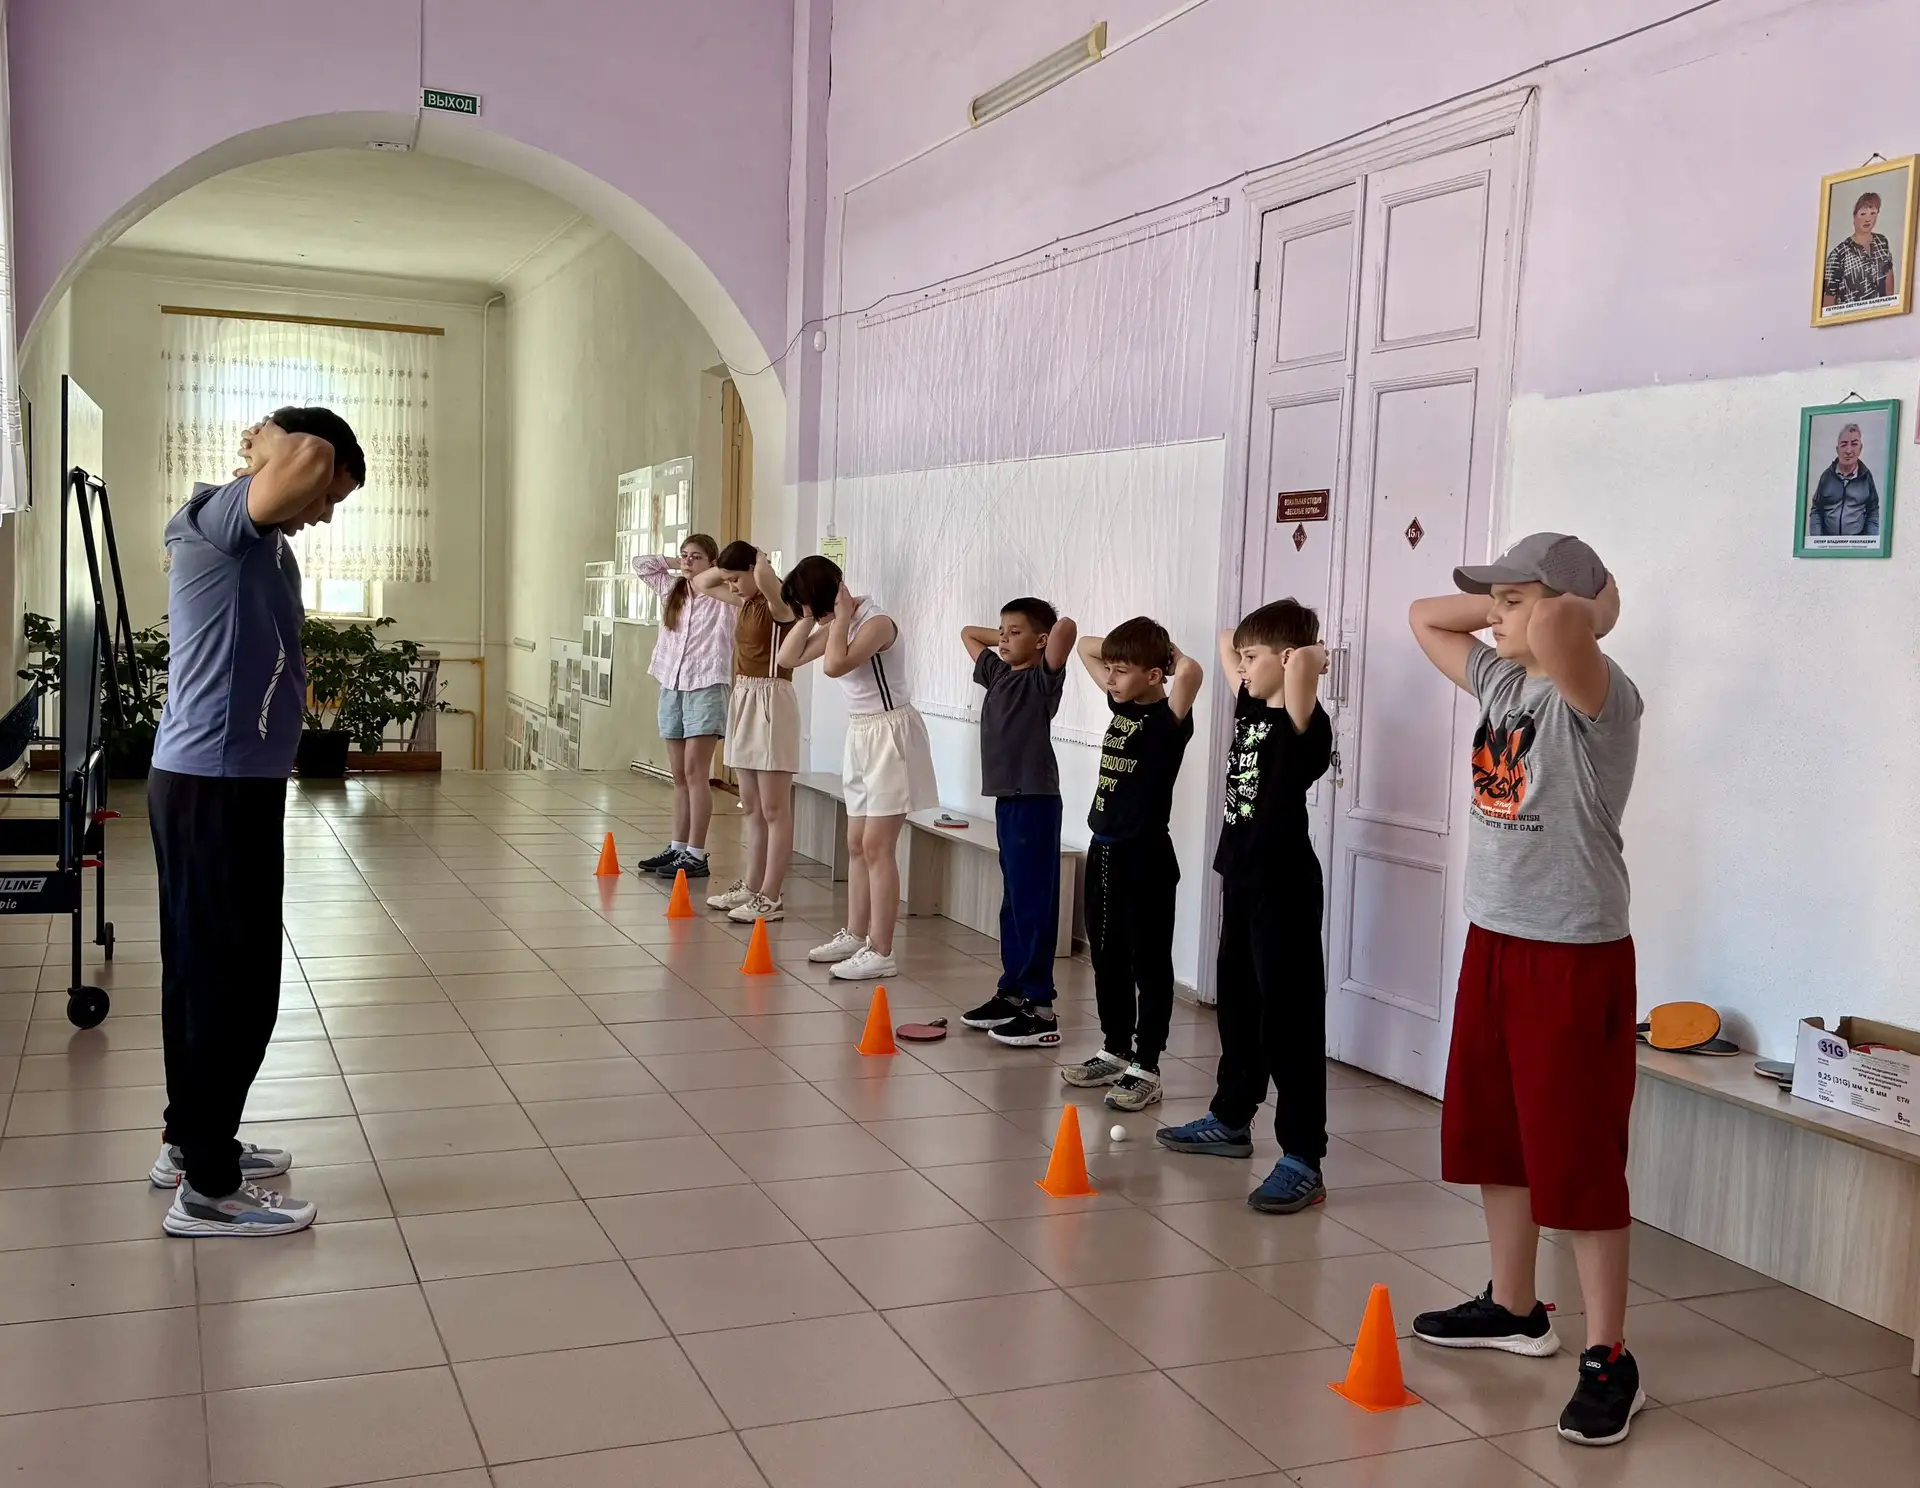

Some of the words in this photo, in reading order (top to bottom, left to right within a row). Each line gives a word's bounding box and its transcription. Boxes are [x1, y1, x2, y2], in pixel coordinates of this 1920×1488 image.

[428, 94, 473, 112] ВЫХОД
[1518, 814, 1541, 822] WISH
[1503, 823, 1519, 831] THE
[1520, 824, 1545, 832] GAME
[4, 880, 42, 890] LINE
[1821, 1040, 1844, 1058] 31G
[1817, 1071, 1832, 1082] 0,25
[1833, 1076, 1851, 1089] (31G)
